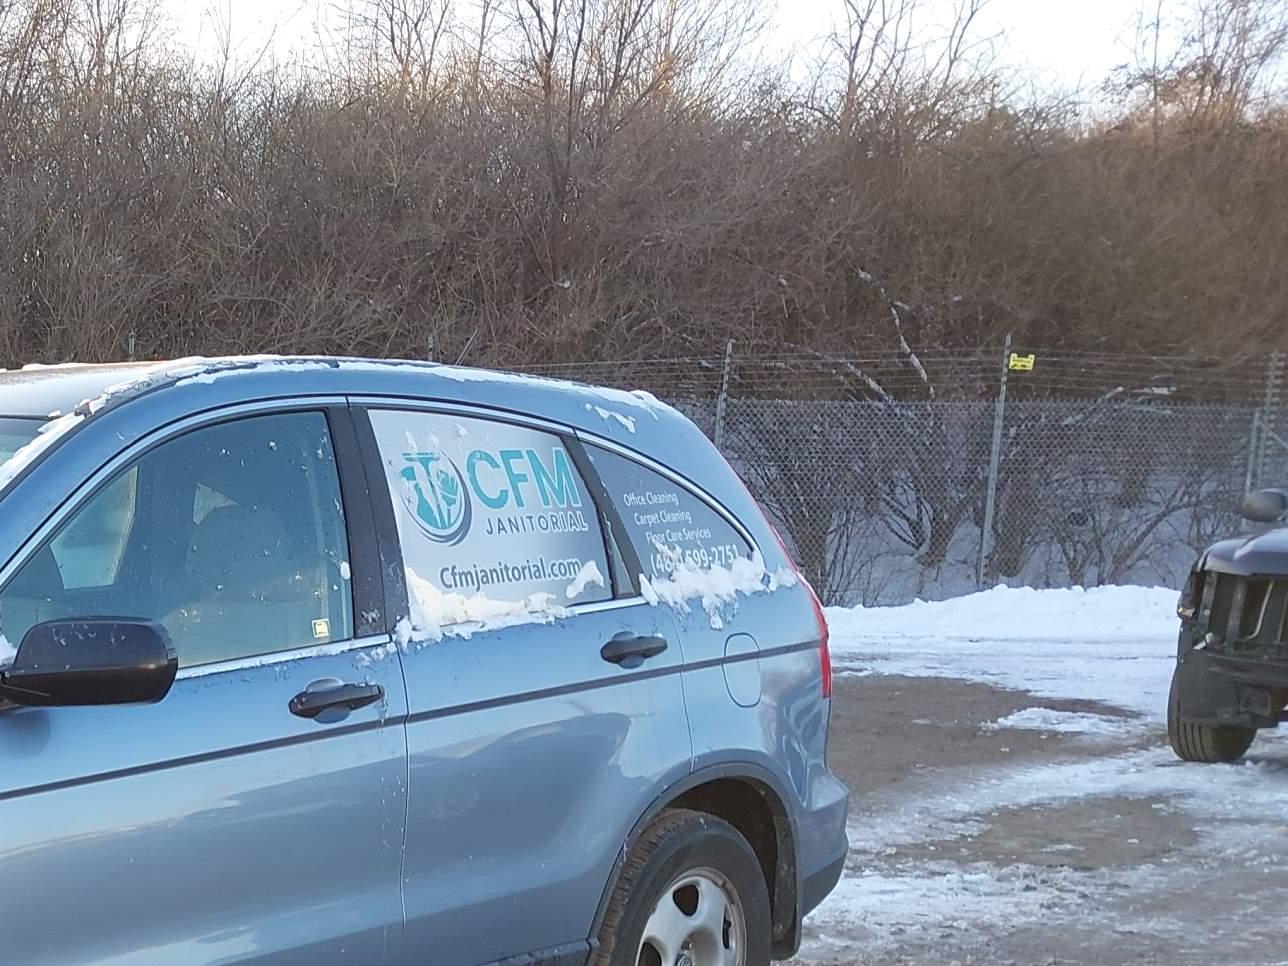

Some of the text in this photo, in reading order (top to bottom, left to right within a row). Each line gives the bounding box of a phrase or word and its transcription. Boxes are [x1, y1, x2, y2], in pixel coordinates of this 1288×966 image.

[466, 447, 582, 509] CFM
[623, 491, 679, 506] Office Cleaning
[486, 512, 588, 535] JANITORIAL
[634, 510, 692, 527] Carpet Cleaning
[645, 527, 711, 545] Floor Care Services
[440, 557, 581, 592] Cfmjanitorial.com
